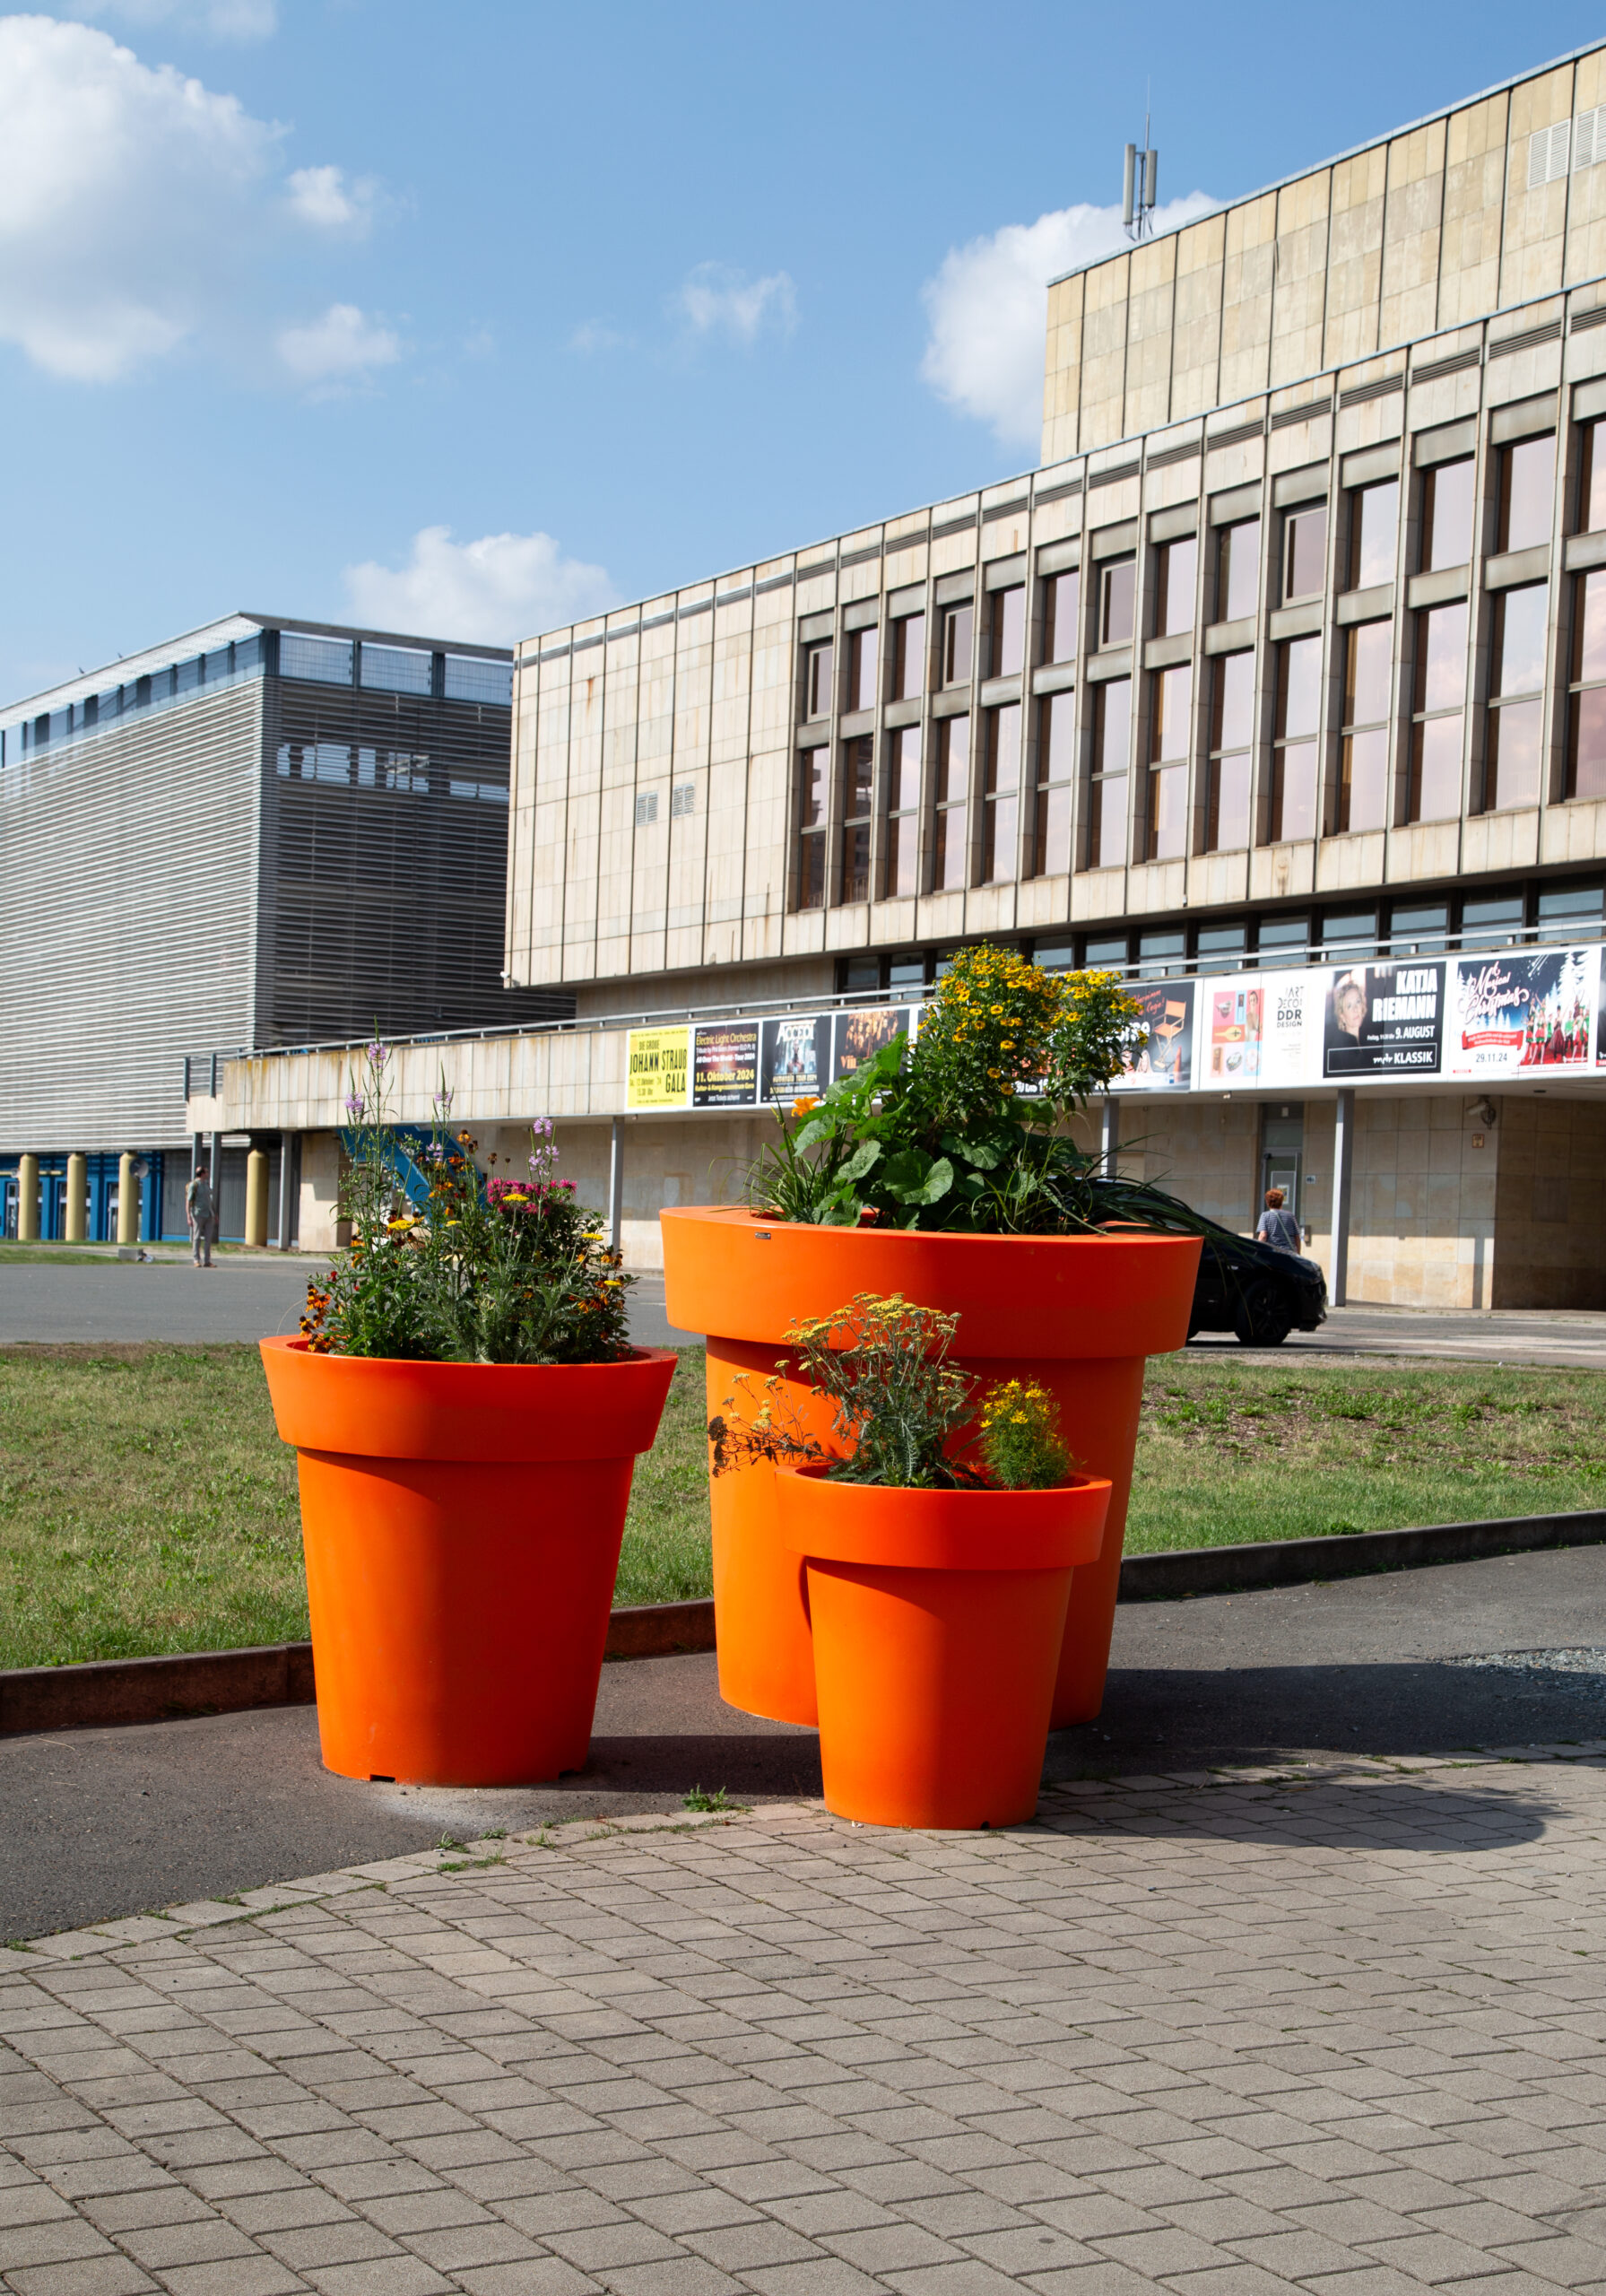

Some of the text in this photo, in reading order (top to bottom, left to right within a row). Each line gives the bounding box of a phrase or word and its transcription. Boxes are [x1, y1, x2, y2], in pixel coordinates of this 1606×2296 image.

[1396, 969, 1437, 995] KATJA
[1468, 966, 1511, 998] Musical
[1372, 994, 1437, 1022] RIEMANN
[1458, 986, 1529, 1025] Christmas
[1277, 1009, 1302, 1021] DDR
[1277, 1021, 1302, 1029] DESIGN
[1395, 1027, 1402, 1039] 9.
[1403, 1025, 1436, 1039] AUGUST
[696, 1033, 757, 1047] Electric Light Orchestra
[629, 1051, 659, 1075] JOHANN
[1393, 1050, 1433, 1065] KLASSIK
[1475, 1053, 1507, 1063] 29.11.24
[665, 1072, 686, 1093] GALA
[696, 1069, 754, 1083] 11. Oktober 2024
